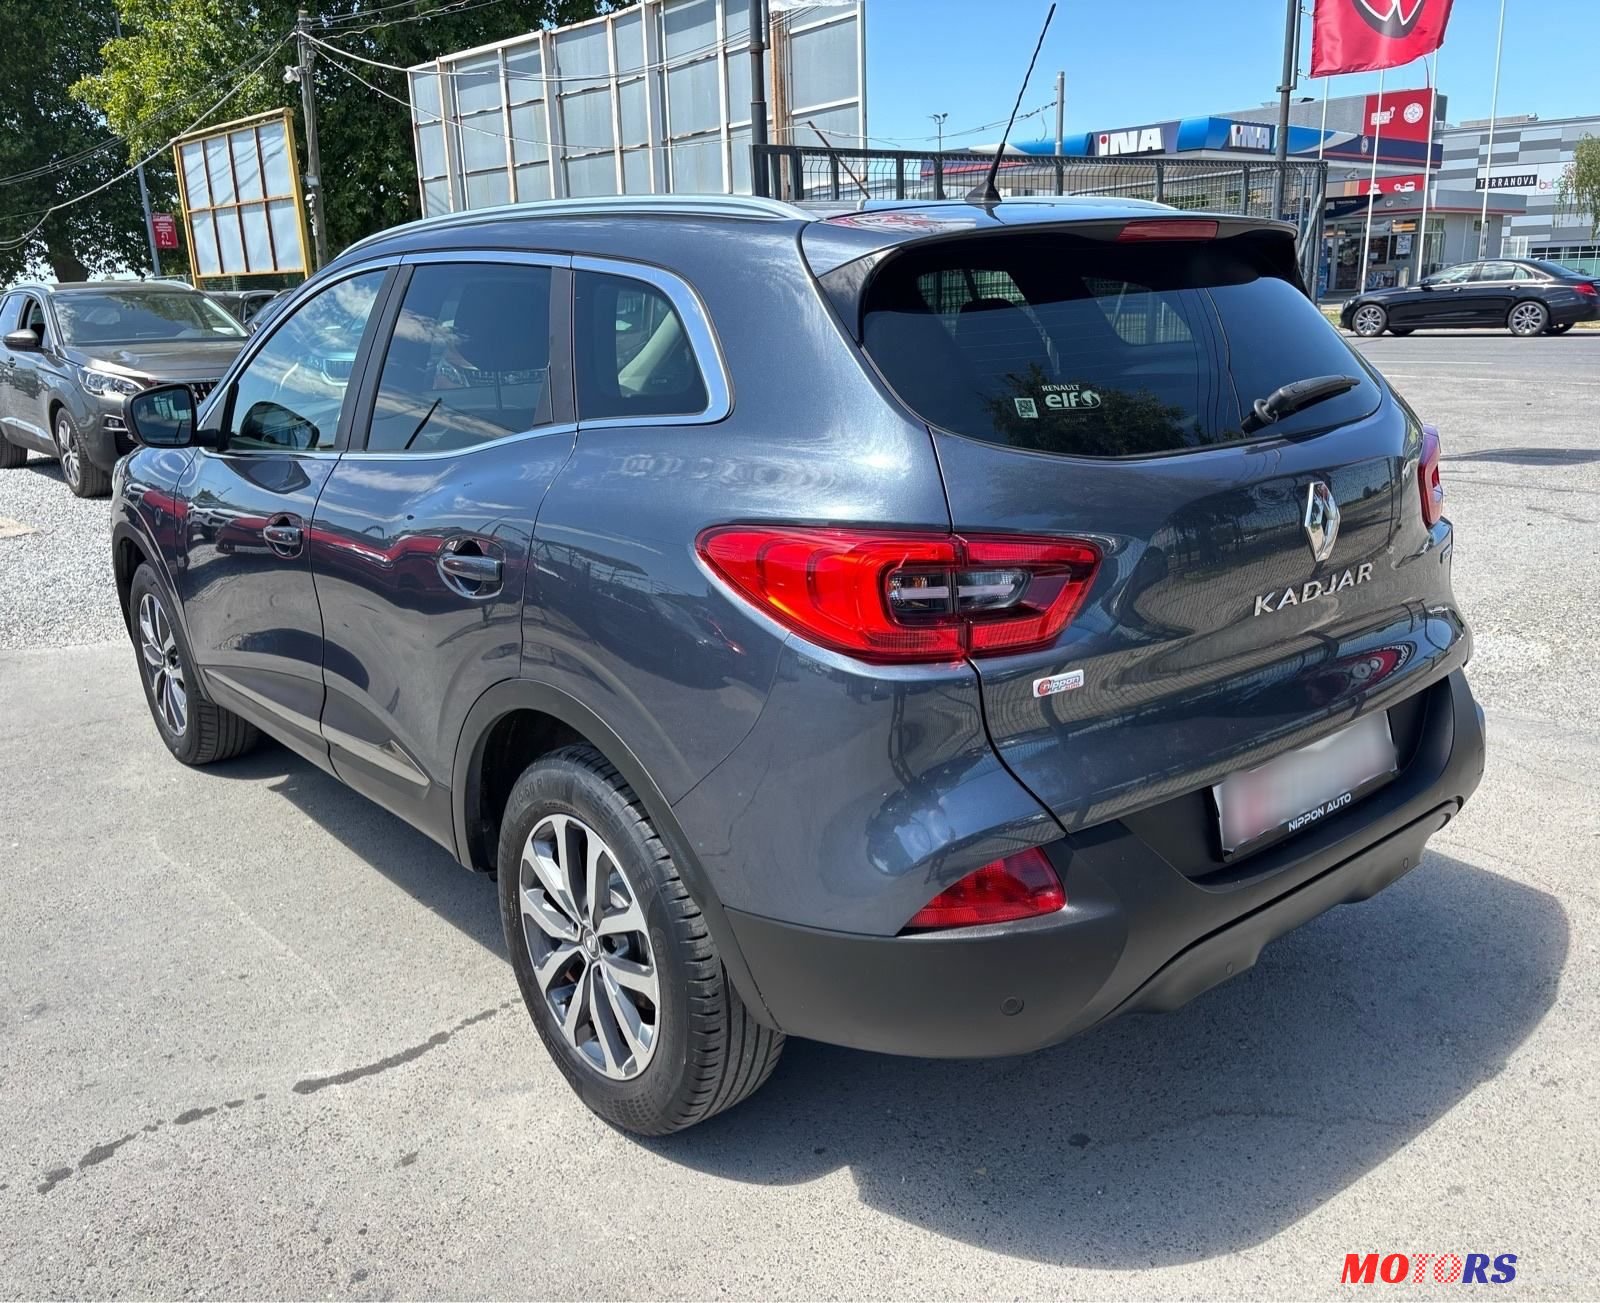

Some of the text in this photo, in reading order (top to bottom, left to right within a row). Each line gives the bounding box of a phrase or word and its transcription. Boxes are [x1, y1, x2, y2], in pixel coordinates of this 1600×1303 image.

[1041, 384, 1080, 392] RENAULT
[1045, 392, 1079, 408] elf
[1254, 562, 1373, 617] KADJAR
[1288, 792, 1352, 832] NIPPON AUTO
